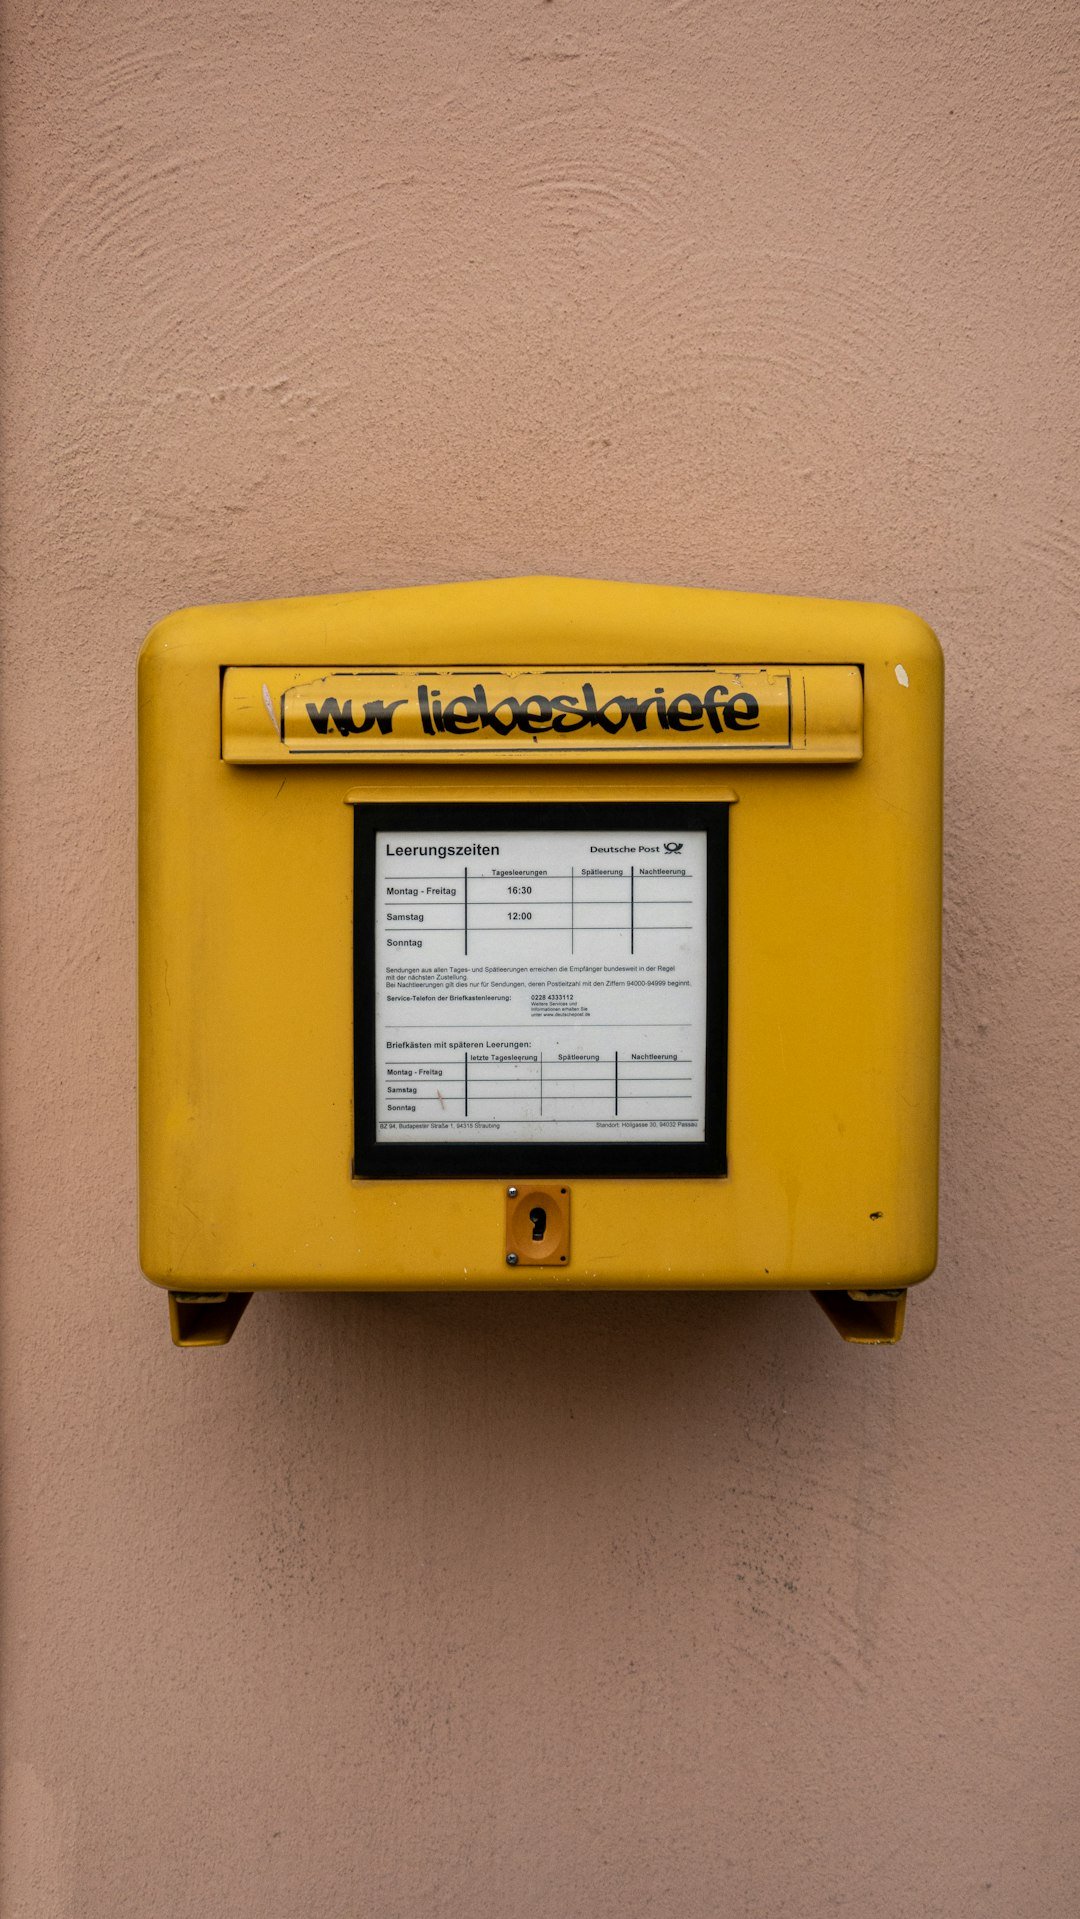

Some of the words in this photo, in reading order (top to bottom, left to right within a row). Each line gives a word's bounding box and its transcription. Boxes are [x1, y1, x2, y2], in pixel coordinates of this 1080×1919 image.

[306, 696, 408, 735] nur
[418, 683, 760, 736] liebesbriefe
[386, 844, 500, 858] Leerungszeiten
[492, 869, 547, 877] Tagesleerungen
[386, 888, 419, 896] Montag
[426, 887, 456, 896] Freitag
[508, 886, 532, 894] 16:30
[386, 913, 424, 922] Samstag
[508, 912, 532, 920] 12:00
[386, 939, 423, 947] Sonntag
[492, 1054, 537, 1062] Tagesleerung
[558, 1054, 599, 1062] Spätleerung
